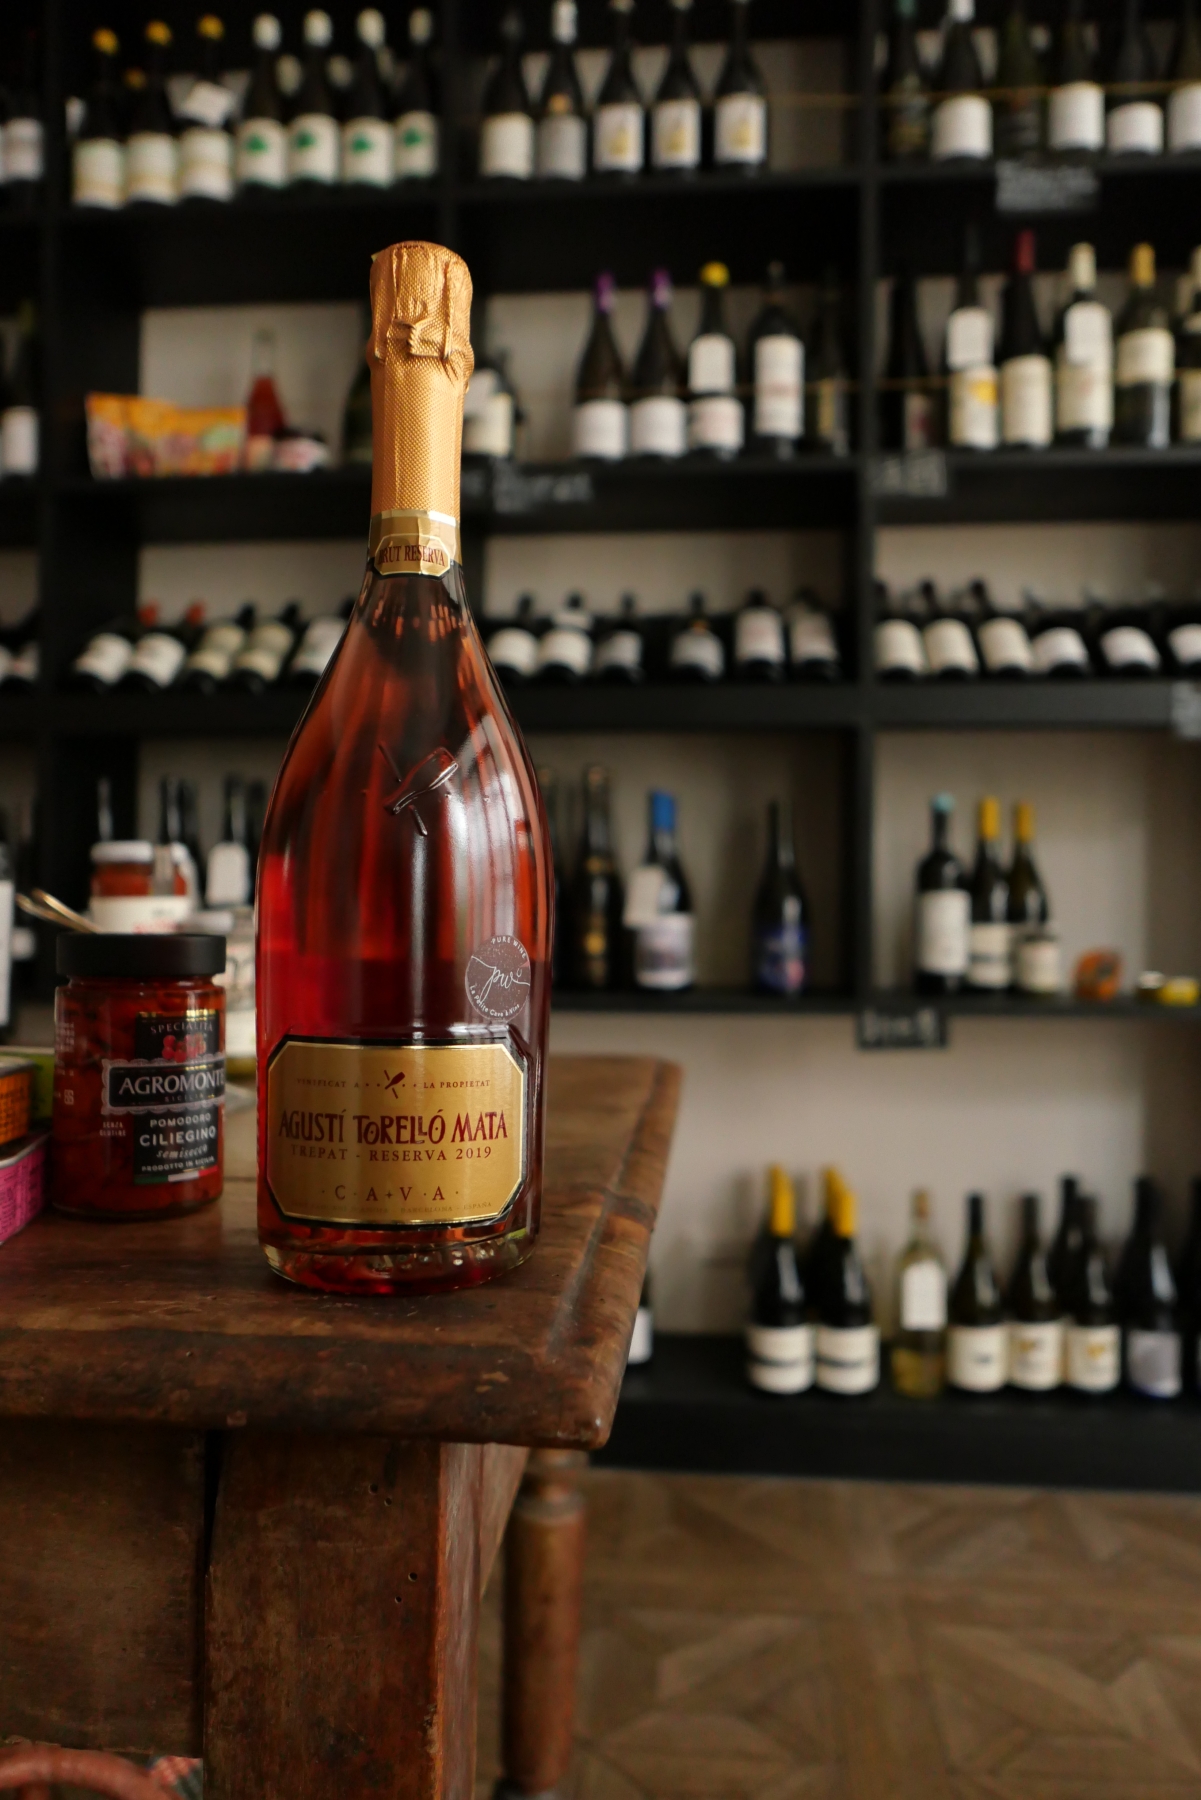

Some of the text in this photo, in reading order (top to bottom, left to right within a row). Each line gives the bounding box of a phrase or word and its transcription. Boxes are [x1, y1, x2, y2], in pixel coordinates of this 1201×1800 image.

[378, 544, 446, 566] BRUT RESERVA
[491, 936, 528, 959] PURE WINE
[296, 1078, 491, 1090] VINIFICAT A LA PROPIETAT
[149, 1112, 212, 1129] POMODORO
[278, 1109, 347, 1142] AGUSTÍ
[450, 1109, 508, 1143] MATA
[139, 1125, 217, 1147] CILIEGINO
[291, 1145, 348, 1160] TREPAT
[368, 1149, 448, 1162] RESERVA
[455, 1146, 492, 1160] 2019
[463, 1201, 492, 1211] ESPAÑA
